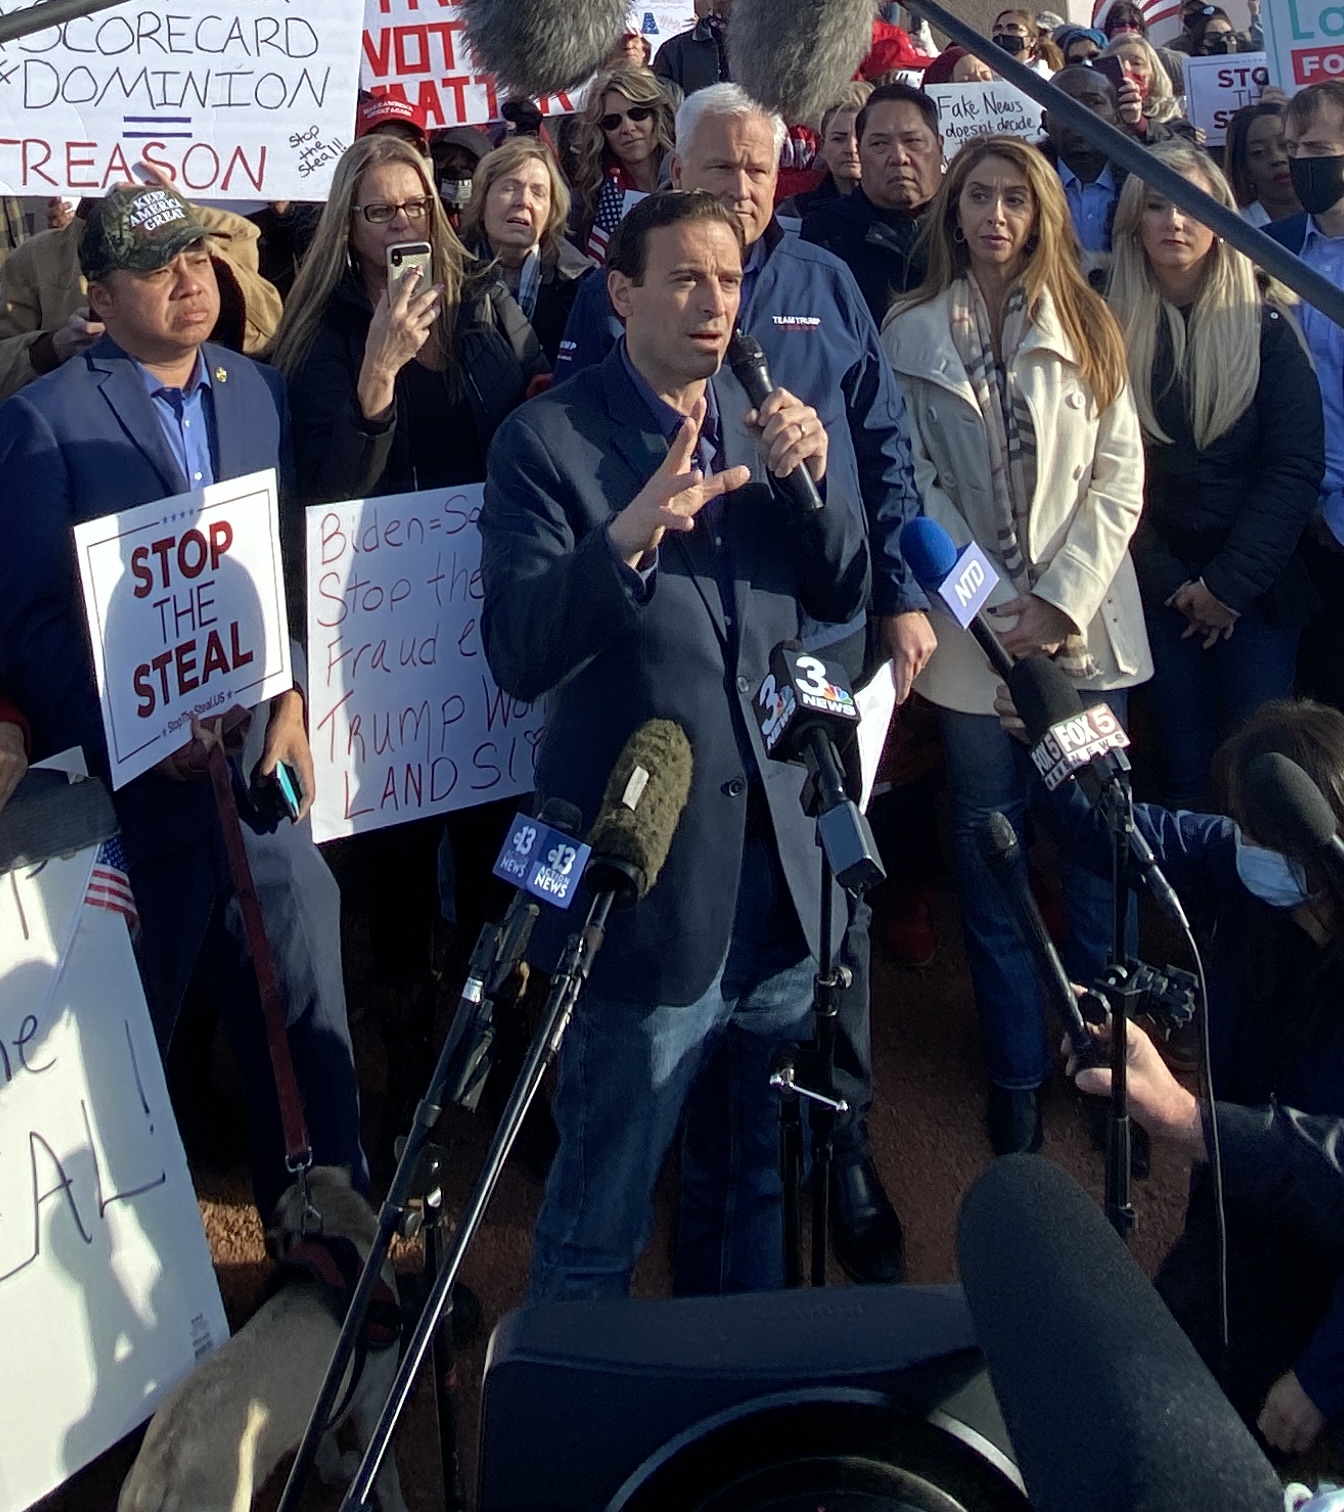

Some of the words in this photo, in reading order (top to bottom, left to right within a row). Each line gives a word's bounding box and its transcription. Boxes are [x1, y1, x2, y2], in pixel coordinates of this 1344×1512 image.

[937, 94, 980, 120] Fake
[982, 91, 1024, 116] News
[129, 197, 184, 228] AMERICA
[133, 190, 167, 210] KEEP
[143, 208, 186, 232] GREAT
[131, 520, 234, 600] STOP
[317, 571, 411, 627] Stop
[426, 550, 486, 606] the
[954, 559, 985, 607] NTD
[152, 580, 218, 644] THE
[132, 621, 254, 719] STEAL
[327, 622, 439, 687] Fraud
[795, 656, 831, 698] 3
[802, 692, 857, 717] NEWS
[1053, 715, 1100, 752] FOX
[1091, 706, 1117, 735] 5
[1070, 732, 1126, 766] NEWS
[534, 873, 569, 898] NEWS
